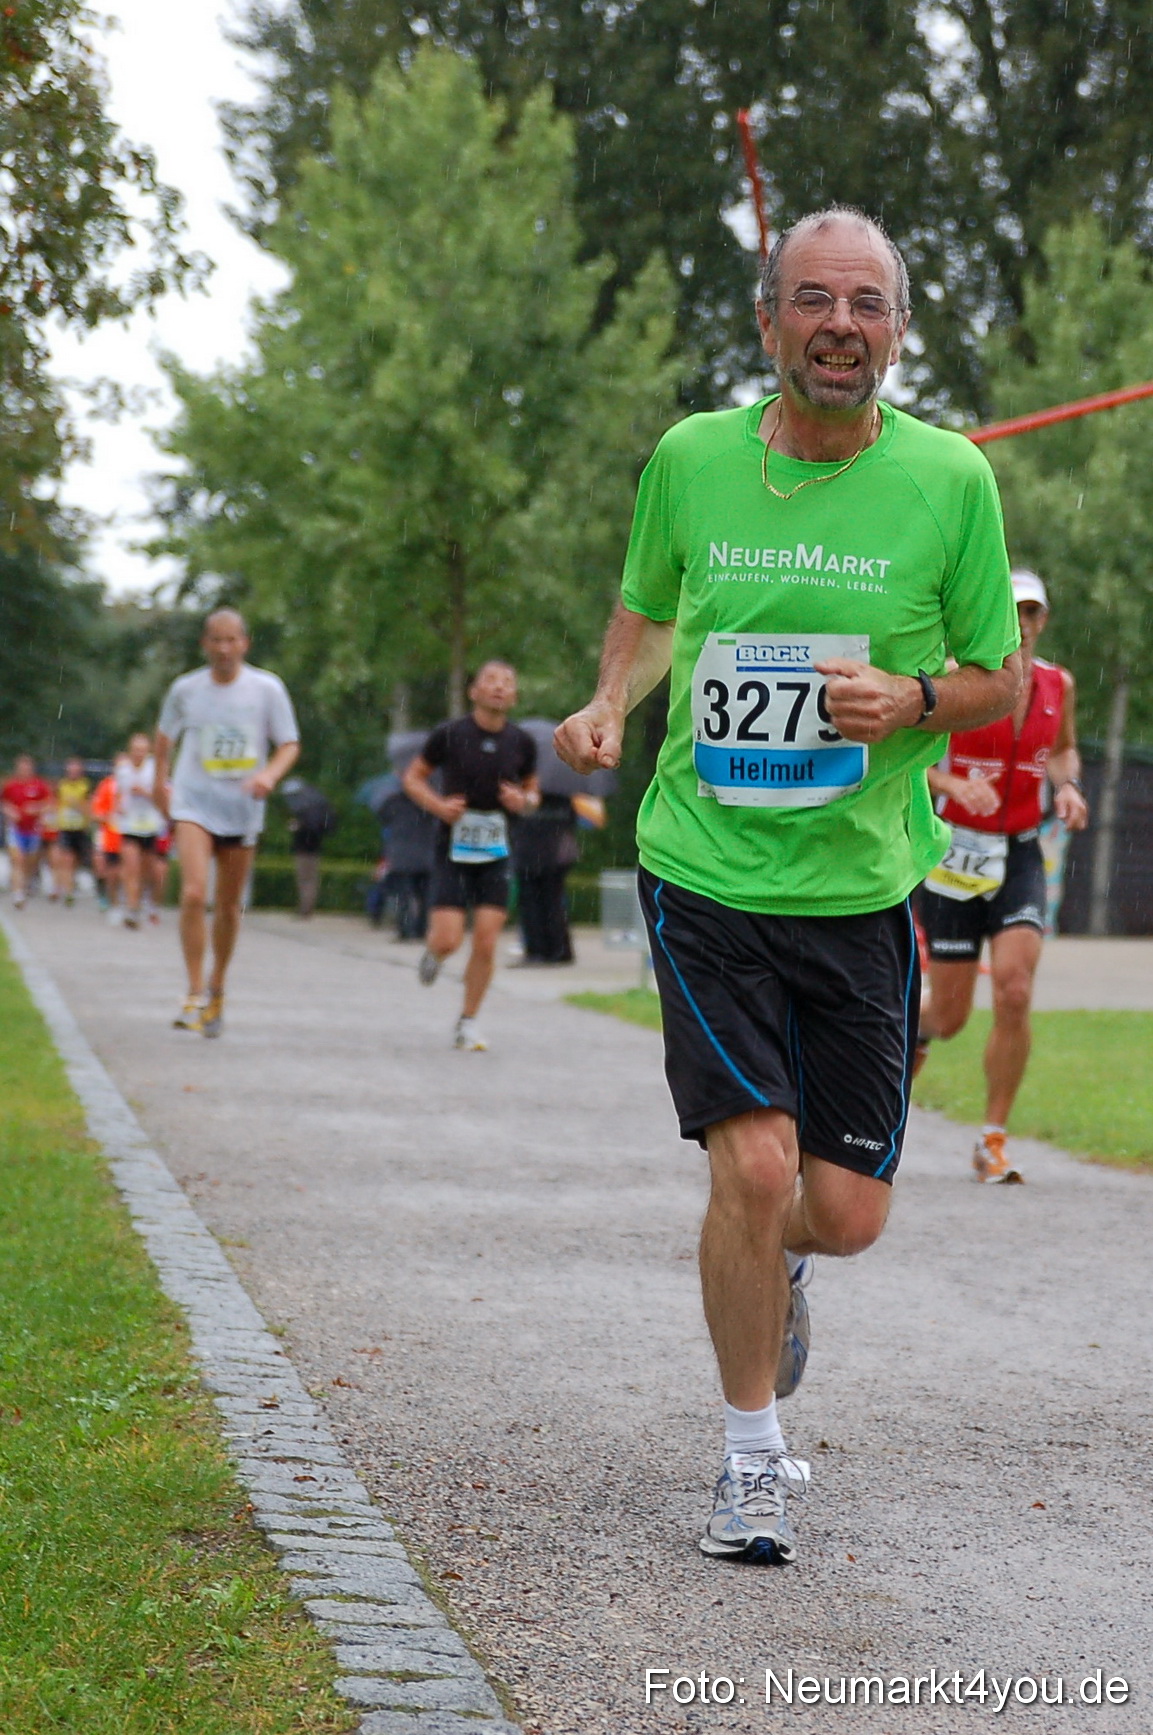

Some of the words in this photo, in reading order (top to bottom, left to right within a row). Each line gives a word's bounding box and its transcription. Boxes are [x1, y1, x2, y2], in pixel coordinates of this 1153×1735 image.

[708, 572, 774, 584] EINKAUFEN.
[780, 574, 841, 589] WOHNEN.
[847, 580, 888, 594] LEBEN.
[736, 645, 810, 662] BOCK
[729, 756, 815, 782] Helmut
